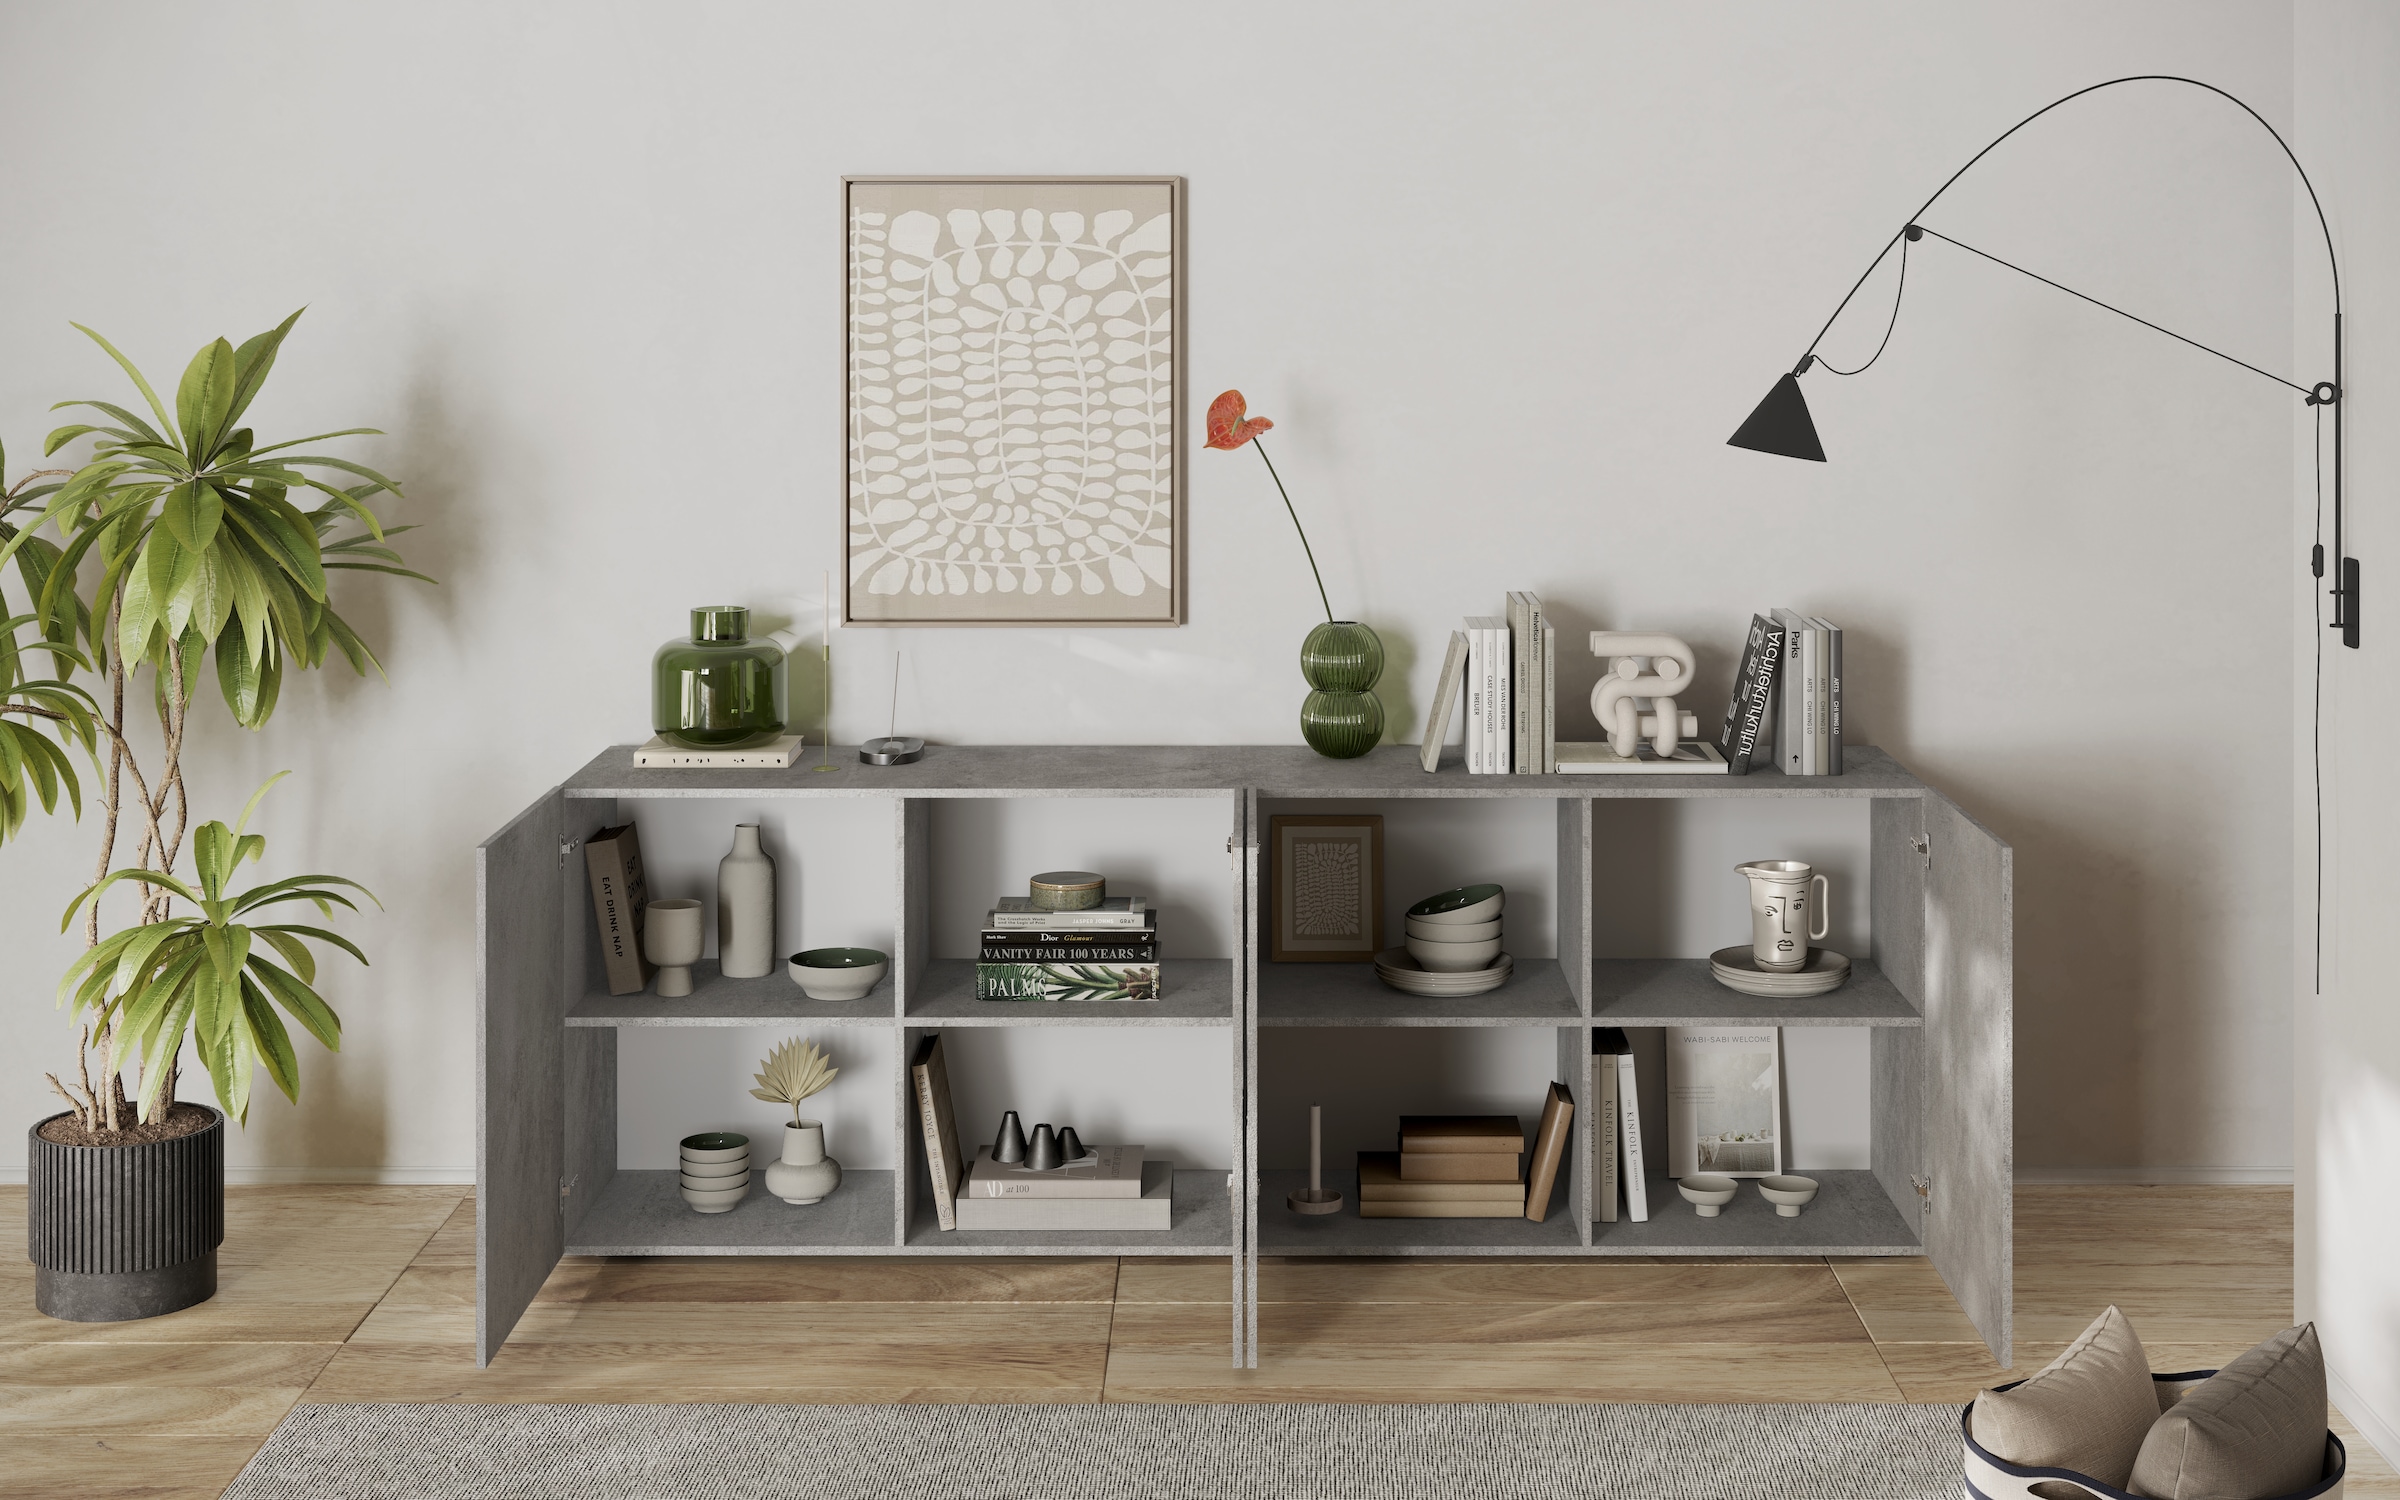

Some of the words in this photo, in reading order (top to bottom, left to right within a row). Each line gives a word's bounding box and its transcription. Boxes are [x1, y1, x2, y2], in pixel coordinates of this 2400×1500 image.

[1791, 631, 1800, 659] Parks
[1807, 727, 1812, 735] LO
[1820, 727, 1826, 735] LO
[1833, 727, 1839, 735] LO
[602, 876, 613, 896] EAT
[606, 900, 619, 933] DRINK
[613, 935, 623, 958] NAP
[1040, 933, 1059, 941] Dior
[1064, 934, 1094, 942] Glamour
[983, 948, 1032, 959] VANITY
[1036, 948, 1066, 959] FAIR
[1070, 948, 1089, 959] 100
[1091, 948, 1135, 959] YEARS
[989, 977, 1047, 997] PALMS
[1732, 1035, 1771, 1043] WELCOME
[917, 1074, 929, 1106] KERRY
[924, 1110, 935, 1140] JOYCE
[1605, 1100, 1613, 1146] KINFOLK
[1627, 1112, 1638, 1156] KINFOLK
[1605, 1151, 1613, 1186] TRAVEL
[984, 1180, 1003, 1197] AD
[1006, 1185, 1013, 1193] at
[1016, 1185, 1029, 1193] 100
